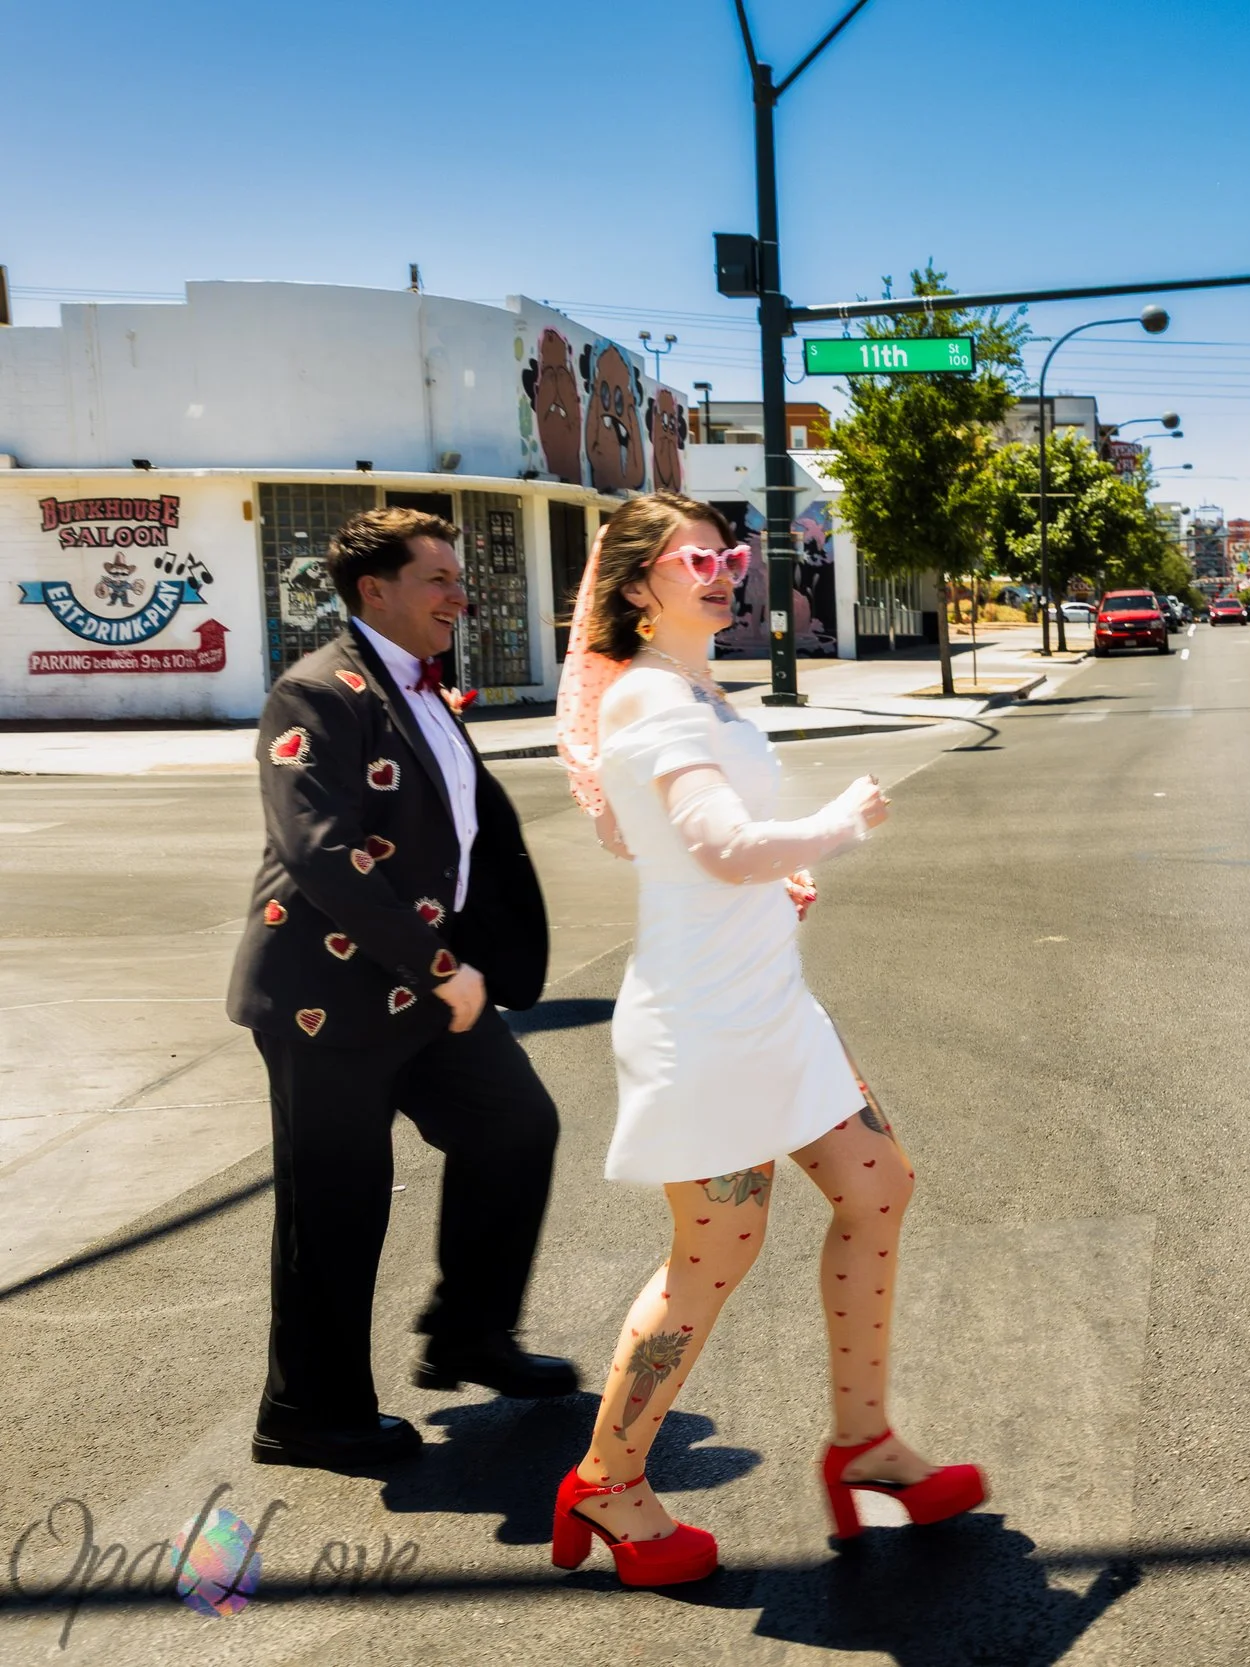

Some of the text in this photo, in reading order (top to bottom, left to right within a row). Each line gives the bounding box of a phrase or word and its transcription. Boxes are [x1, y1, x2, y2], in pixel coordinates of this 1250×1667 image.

[810, 343, 960, 368] S 11th St
[949, 355, 969, 366] 100
[39, 494, 180, 532] BUNKHOUSE
[58, 525, 169, 549] SALOON
[47, 581, 182, 641] EAT DRINK PLAY
[32, 654, 196, 670] PARKING between 9th & 10th
